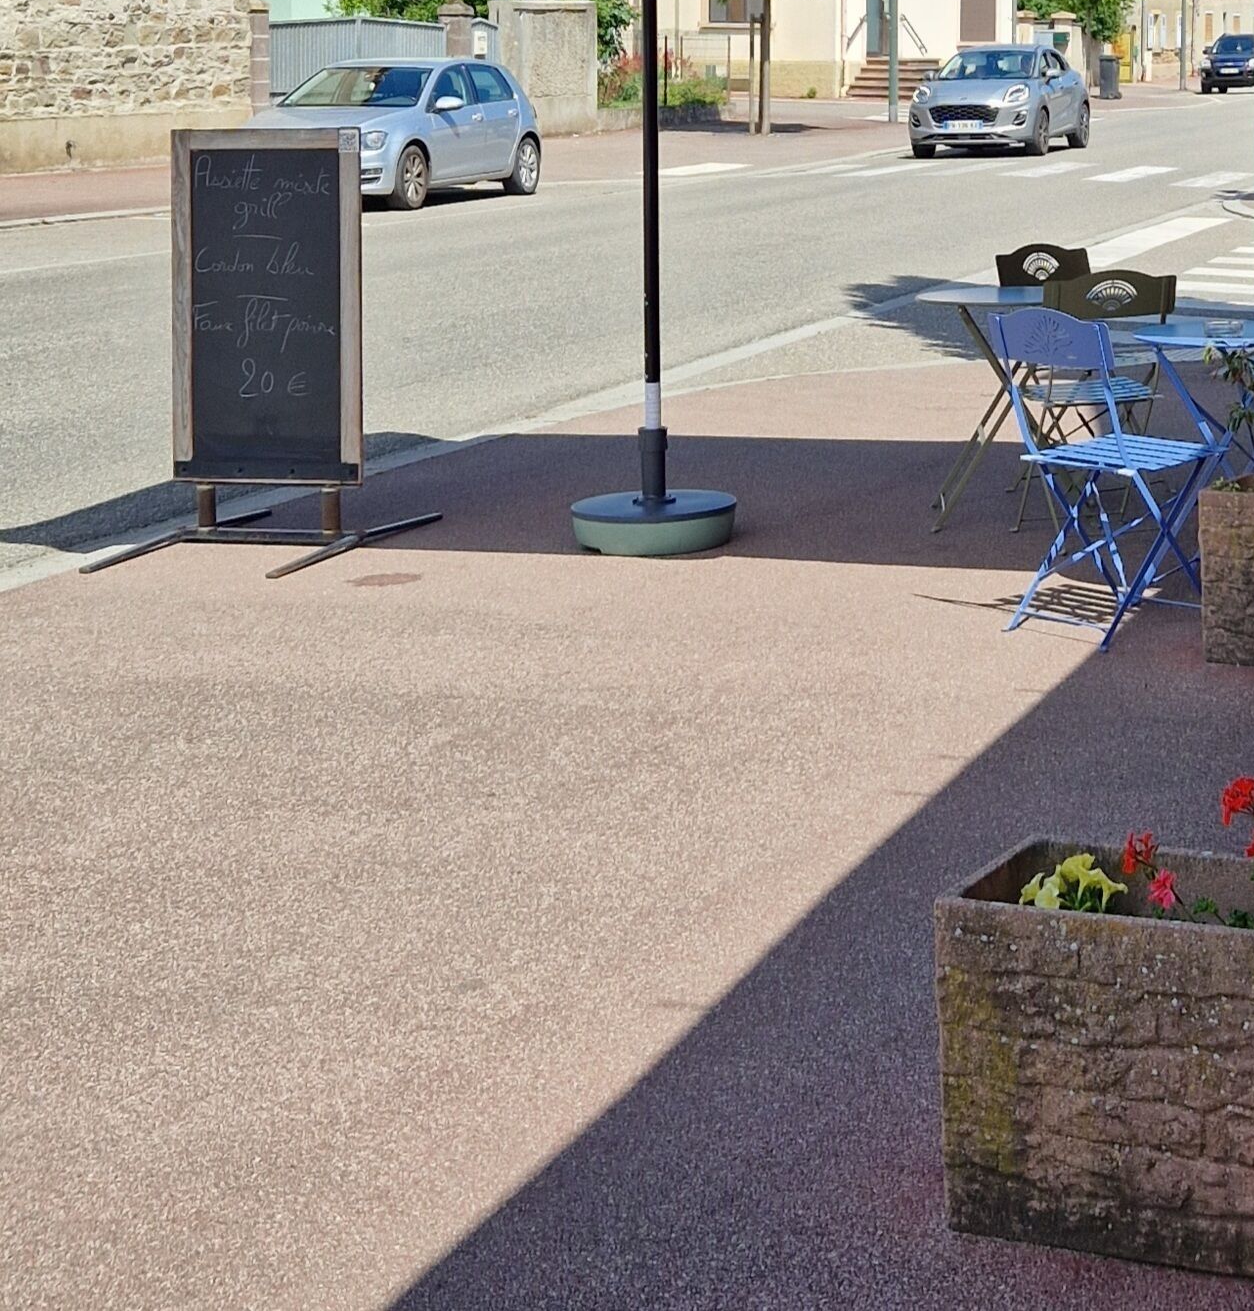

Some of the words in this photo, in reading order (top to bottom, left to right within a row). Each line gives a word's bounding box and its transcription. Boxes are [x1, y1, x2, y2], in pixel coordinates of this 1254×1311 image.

[194, 153, 263, 190] Assiette
[232, 191, 293, 231] grill
[194, 246, 254, 273] Cordon
[265, 241, 315, 275] bleu
[193, 301, 233, 331] Faux
[236, 297, 291, 349] filet
[238, 357, 275, 398] 20
[287, 371, 311, 397] €
